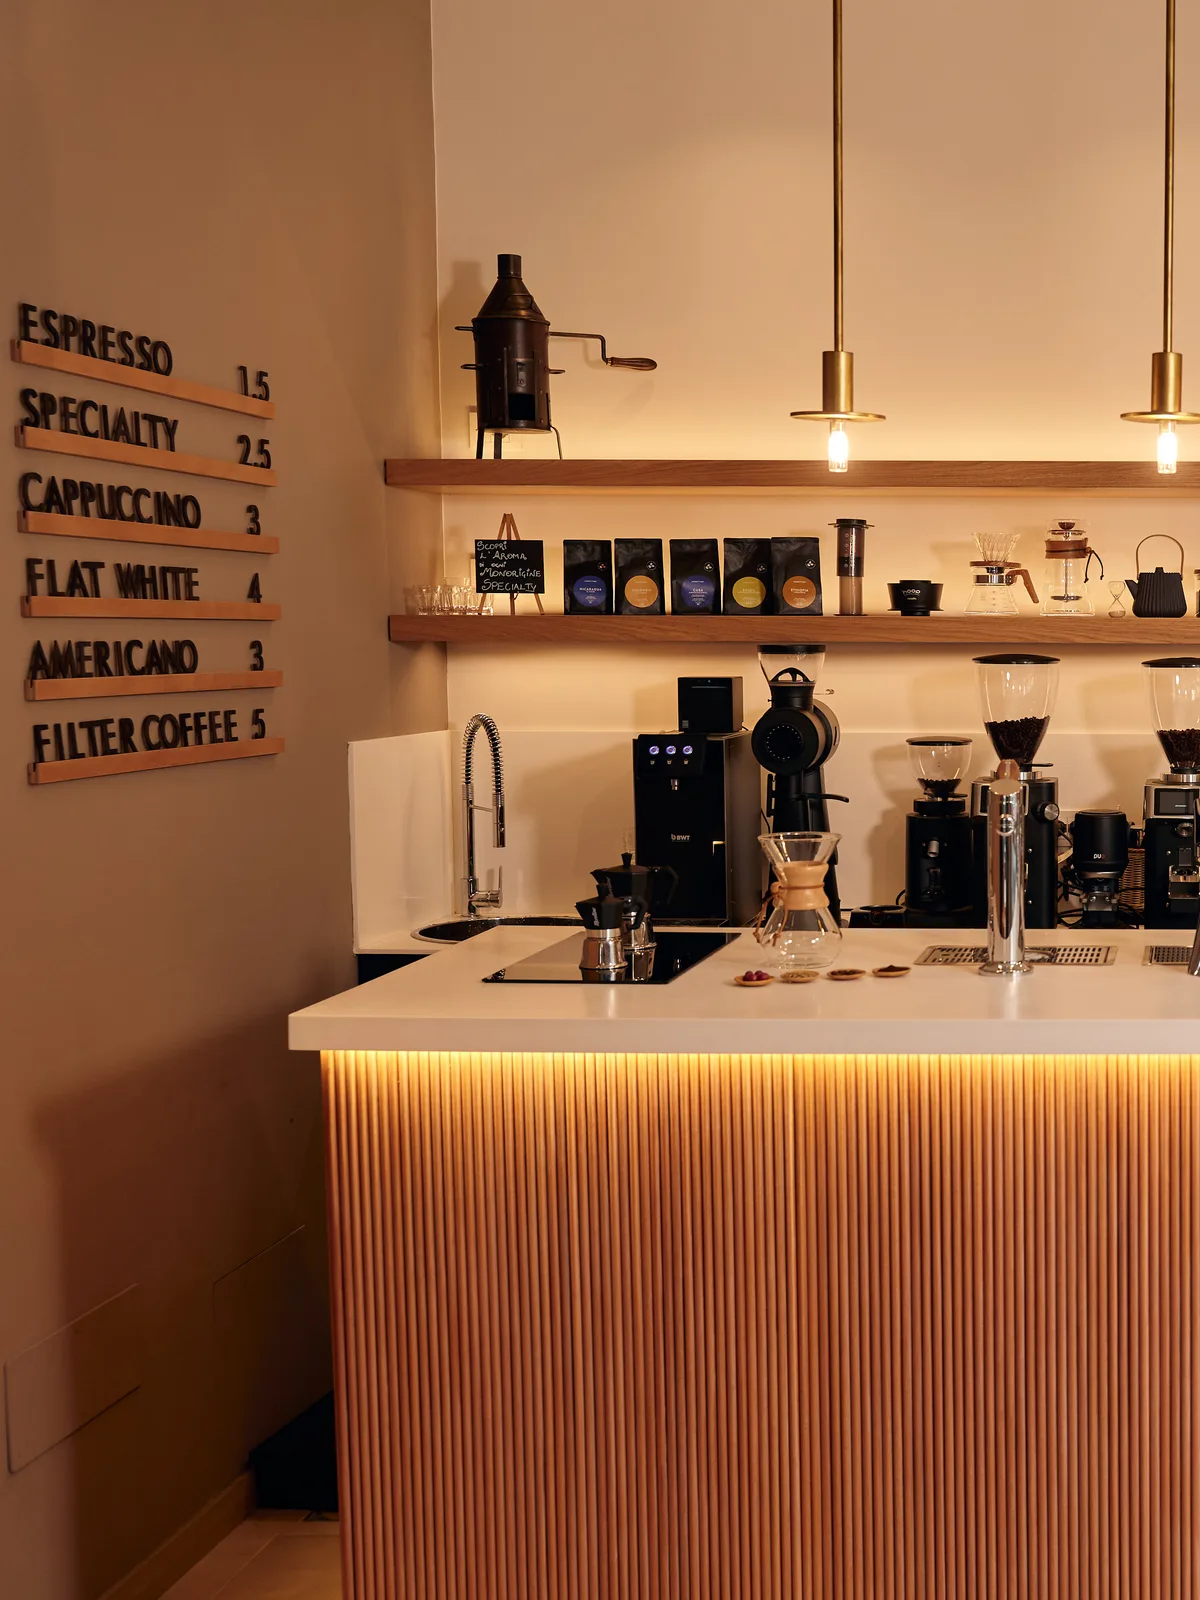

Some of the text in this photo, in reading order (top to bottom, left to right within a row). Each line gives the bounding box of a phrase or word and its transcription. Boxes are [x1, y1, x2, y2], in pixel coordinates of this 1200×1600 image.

[18, 302, 270, 401] ESPRESSO 1.5
[20, 388, 272, 469] SPECIALTY 2.5
[19, 472, 261, 535] CAPPUCCINO 3
[25, 557, 262, 603] FLAT WHITE 4
[30, 639, 264, 679] AMERICANO 3
[32, 708, 267, 762] FILTER COFFEE 5
